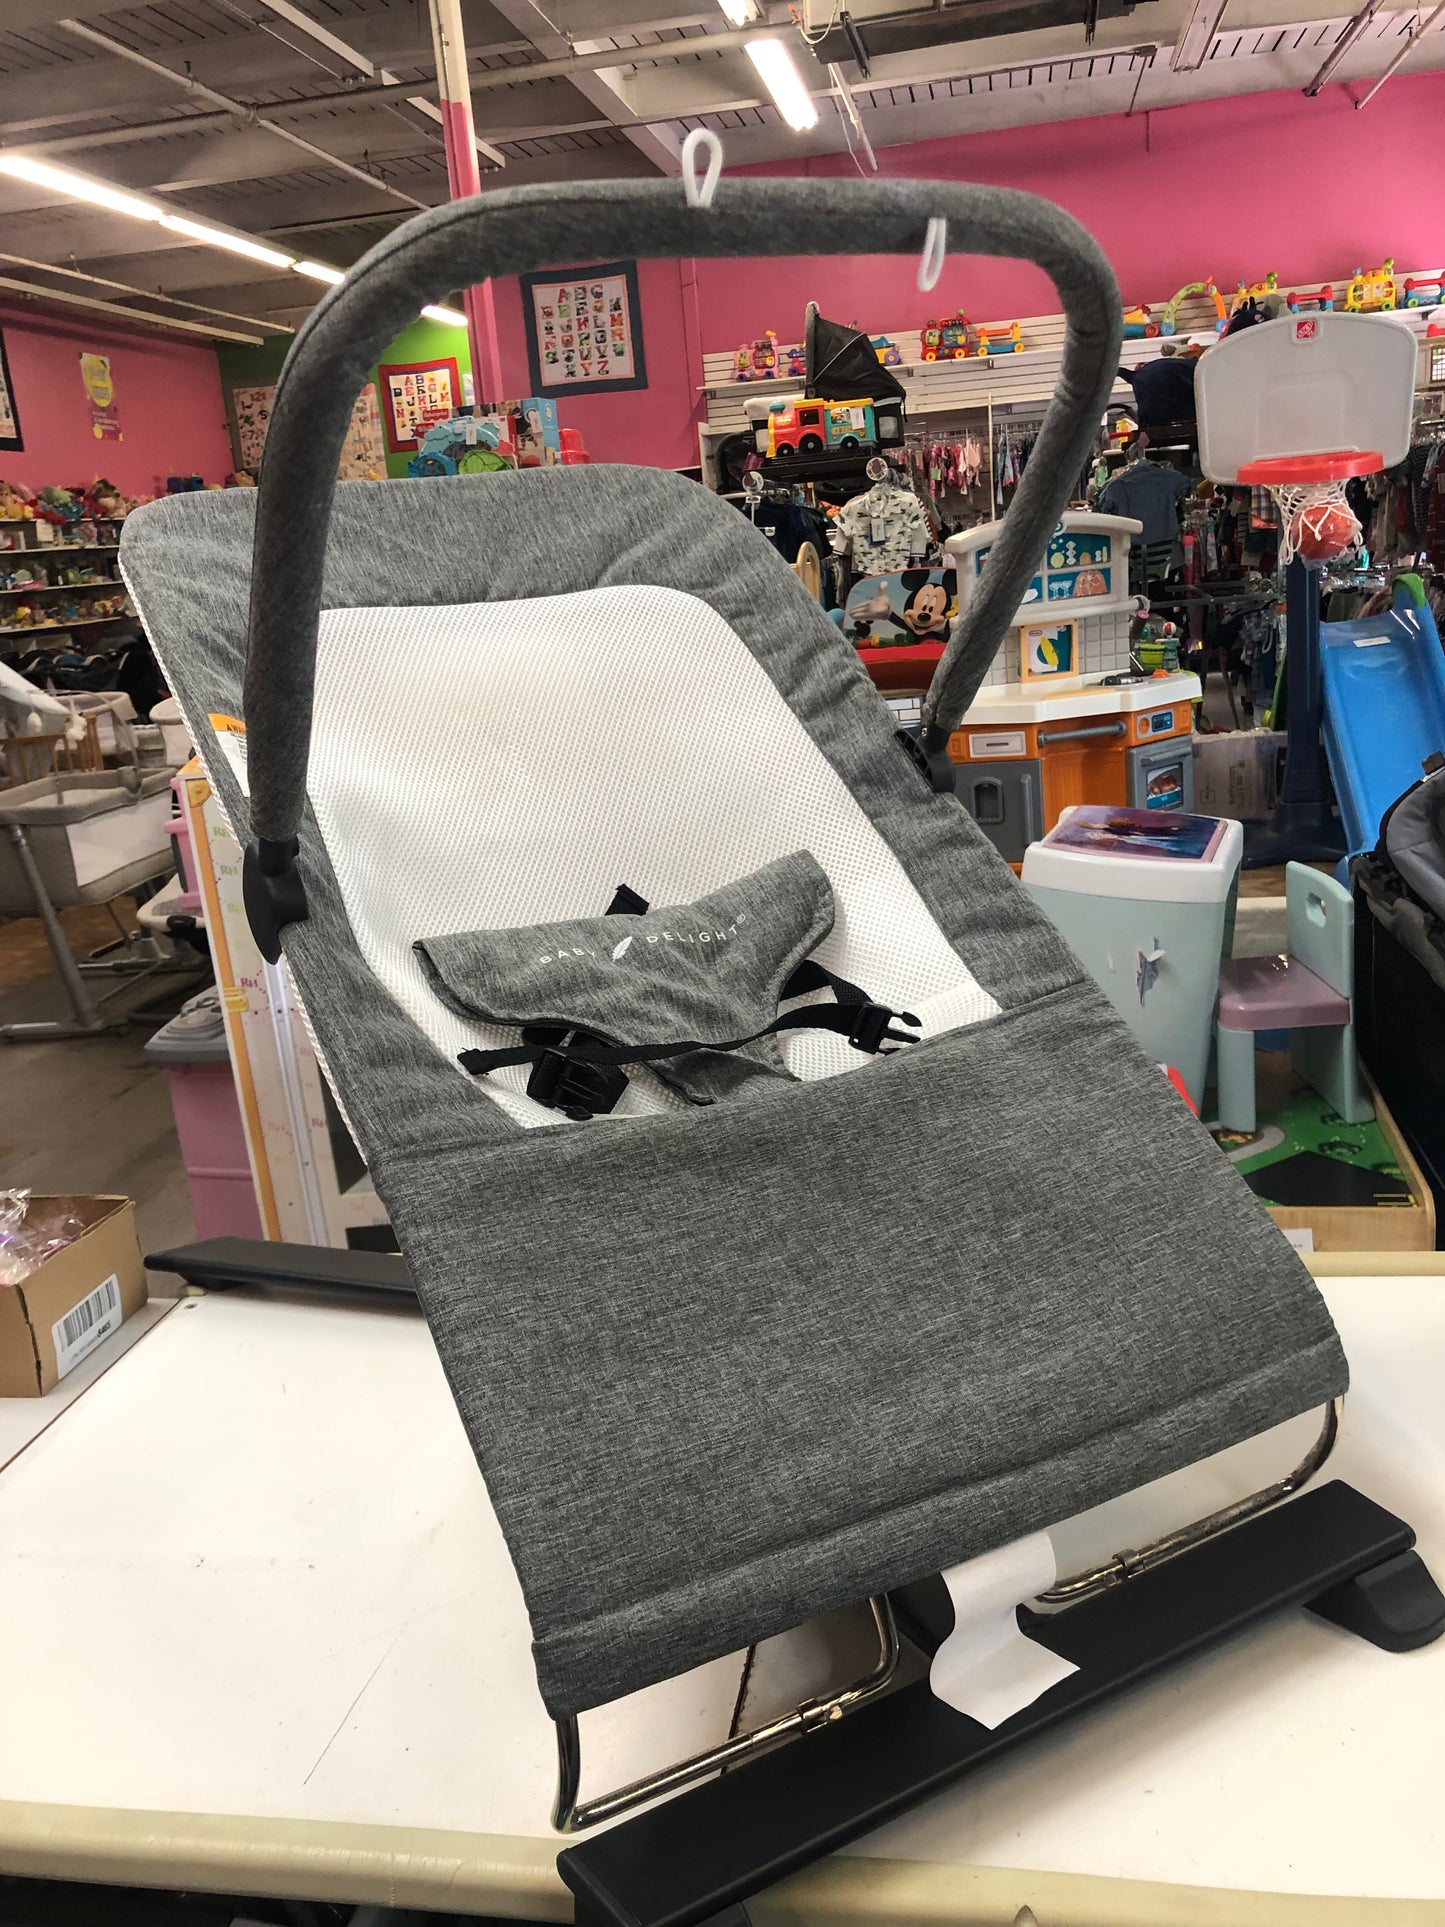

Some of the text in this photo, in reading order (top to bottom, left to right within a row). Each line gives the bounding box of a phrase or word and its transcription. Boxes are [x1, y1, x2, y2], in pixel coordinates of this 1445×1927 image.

[405, 375, 424, 386] A B
[407, 397, 414, 406] J
[418, 396, 426, 405] K
[429, 395, 437, 403] L
[396, 409, 404, 418] N
[539, 947, 596, 964] BABY
